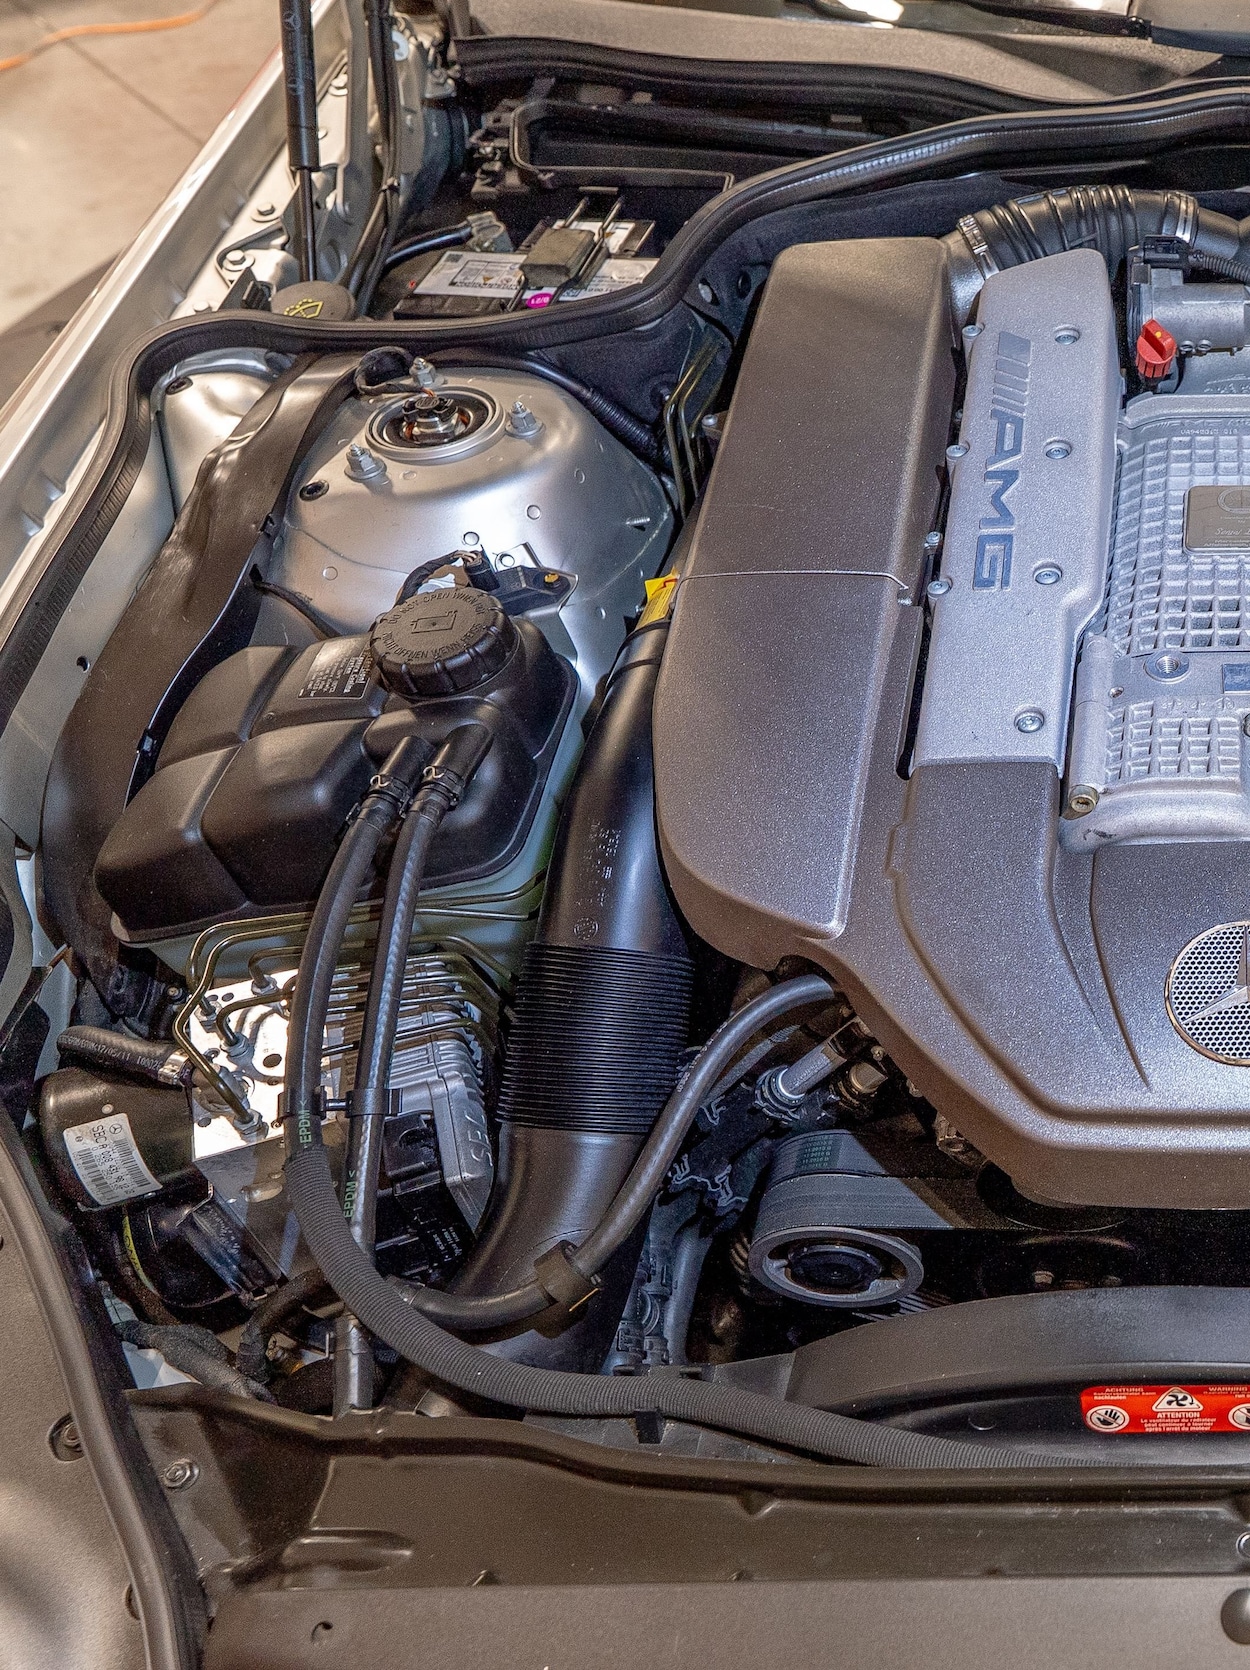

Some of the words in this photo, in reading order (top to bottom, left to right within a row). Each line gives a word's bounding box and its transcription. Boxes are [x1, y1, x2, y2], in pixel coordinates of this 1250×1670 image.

[973, 408, 1025, 591] AMG
[424, 592, 449, 604] OPEN
[298, 1110, 312, 1143] EPDM
[343, 1181, 358, 1217] EPDM
